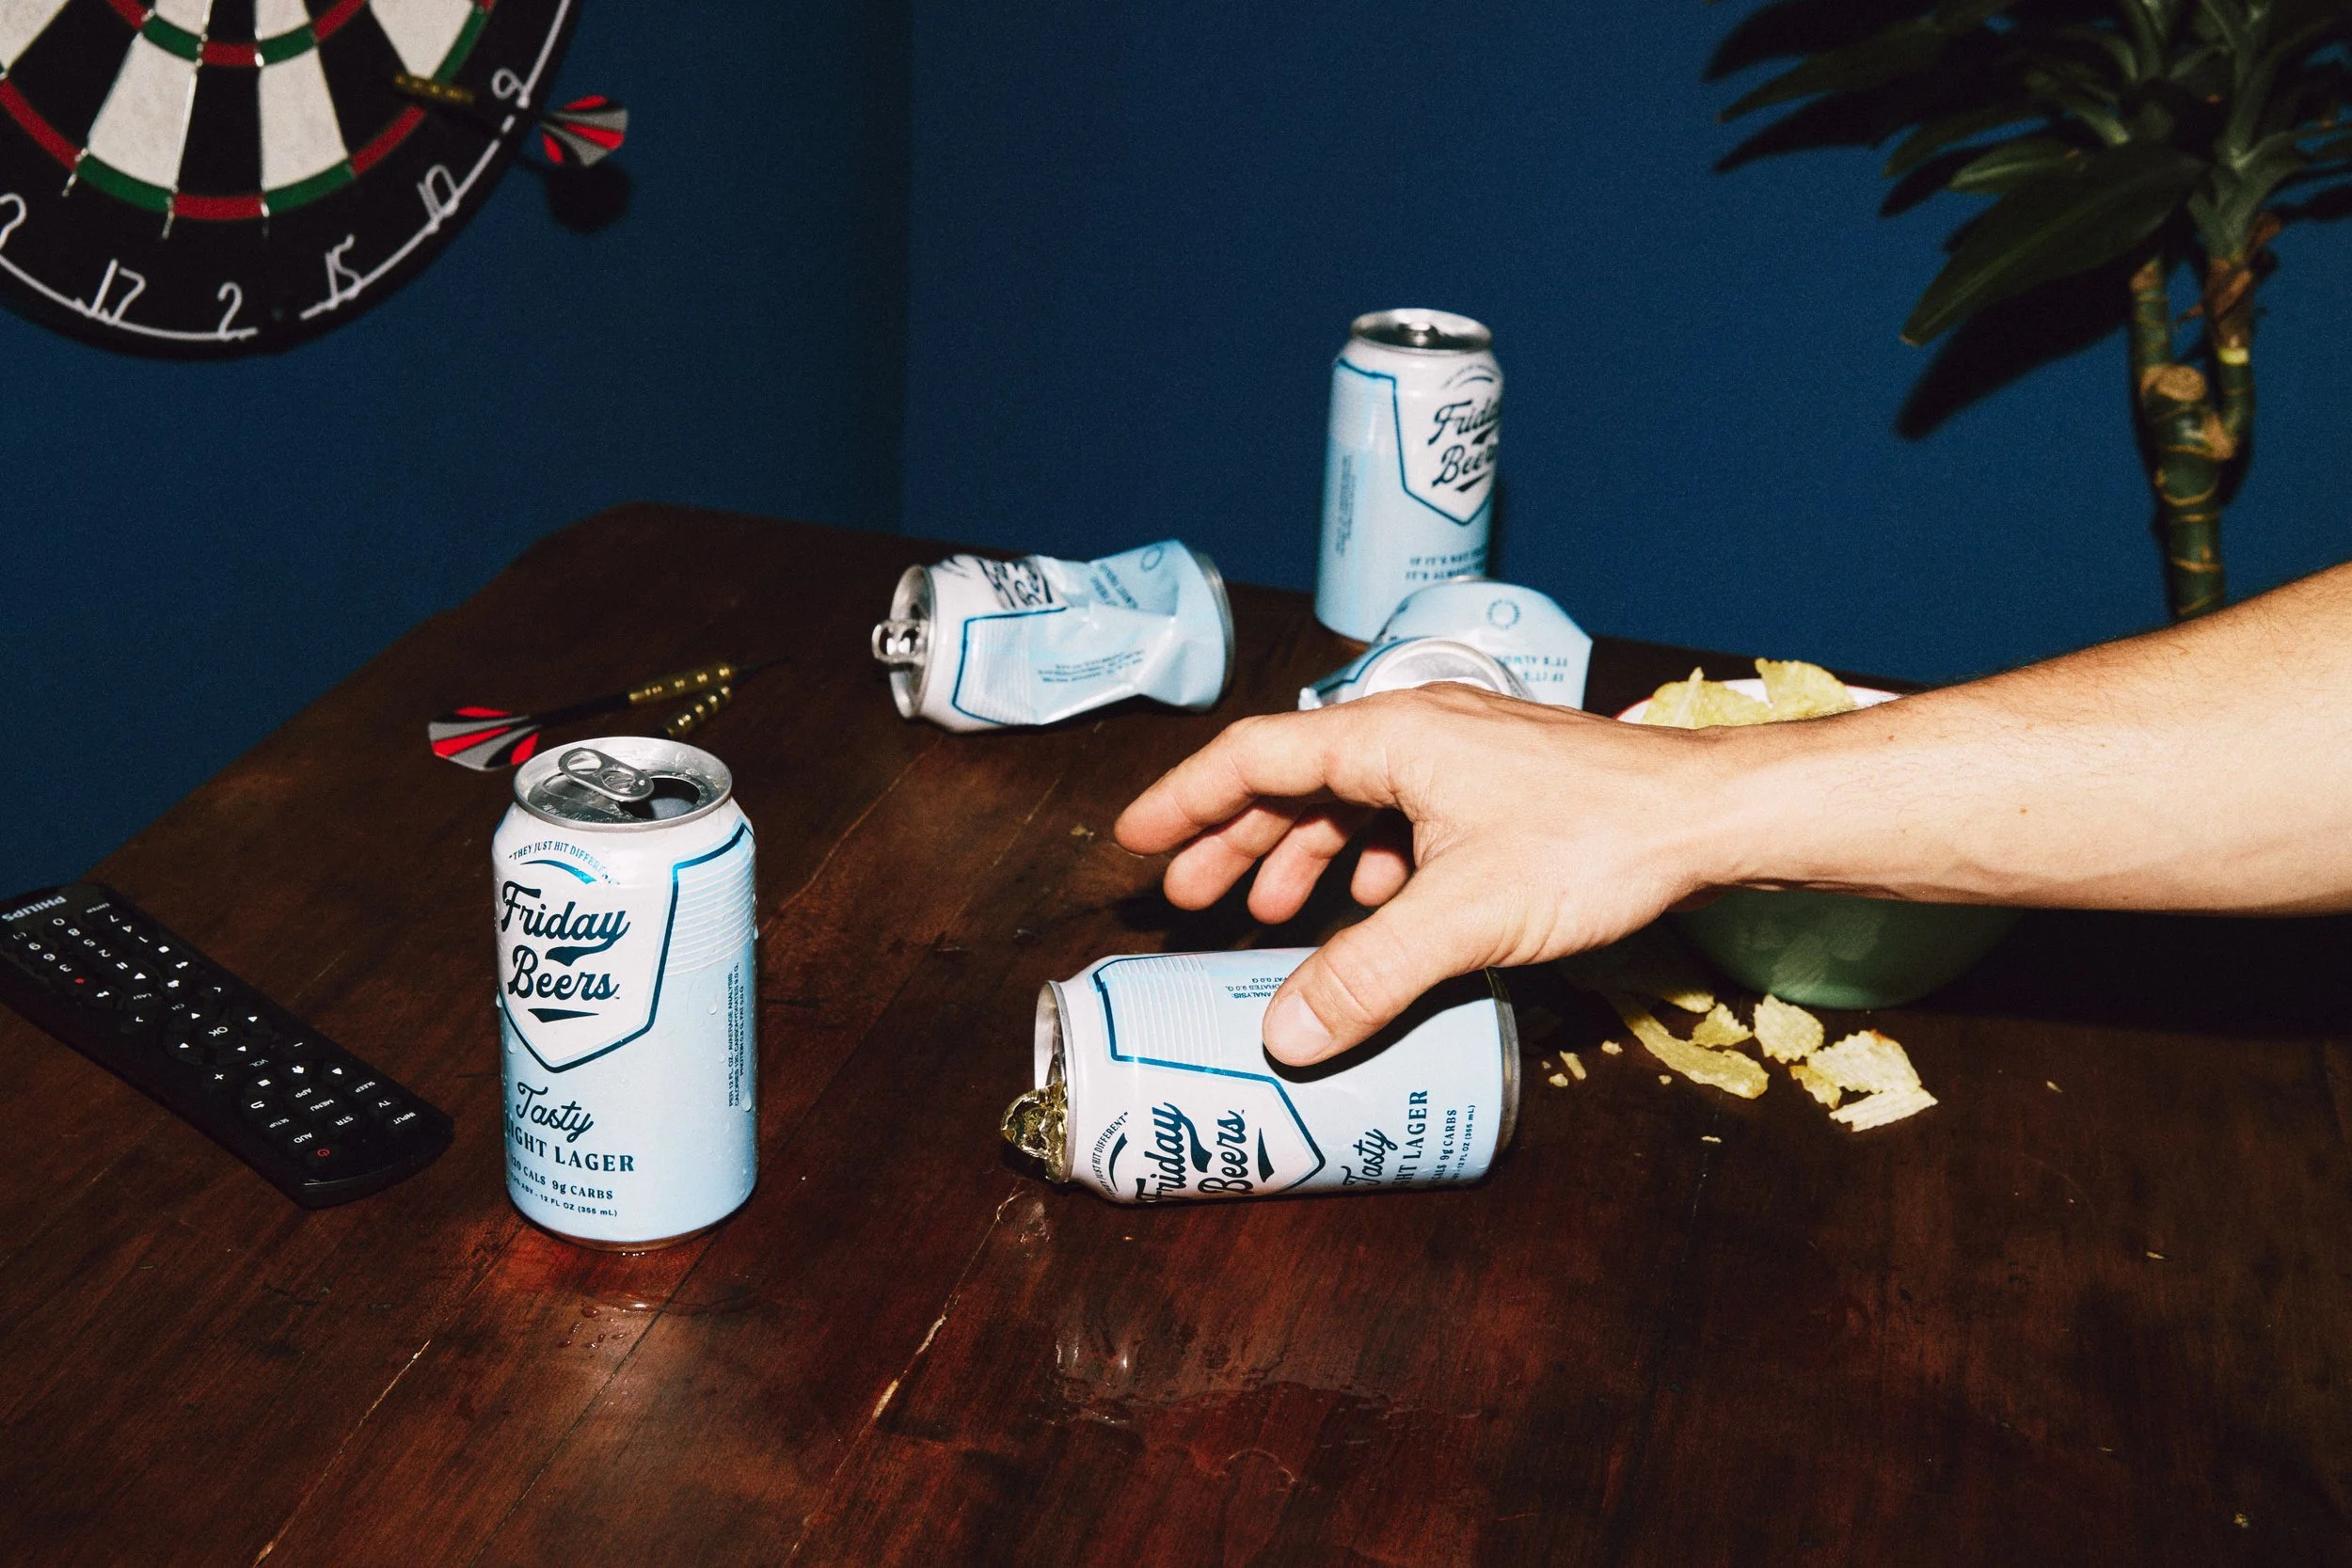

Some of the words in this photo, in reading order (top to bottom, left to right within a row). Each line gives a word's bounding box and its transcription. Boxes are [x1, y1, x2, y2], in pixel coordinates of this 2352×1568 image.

[417, 164, 460, 228] 10
[325, 234, 365, 305] 15
[89, 258, 147, 323] 17
[216, 282, 248, 341] 2
[533, 840, 553, 853] JUST
[554, 841, 569, 853] HIT
[1, 895, 67, 922] PHILIPS
[501, 880, 630, 967] Friday
[83, 939, 96, 947] 5
[98, 949, 111, 958] 2
[508, 944, 620, 1001] Beers
[208, 1026, 229, 1037] OK
[249, 1058, 269, 1067] VOL
[294, 1087, 312, 1099] APP
[355, 1081, 375, 1093] SLEEP
[728, 1081, 734, 1089] 12
[310, 1099, 334, 1112] MENU
[378, 1100, 391, 1108] TV
[516, 1081, 595, 1143] Tasty
[335, 1116, 354, 1126] STR
[392, 1111, 416, 1125] INPUT
[1402, 1090, 1428, 1159] LAGER
[1443, 1109, 1457, 1146] CARBS
[1464, 1124, 1473, 1140] (355
[294, 1132, 312, 1143] AUD
[1135, 1101, 1213, 1201] Friday
[1197, 1110, 1255, 1195] Beers
[1439, 1148, 1454, 1160] 9g
[1461, 1142, 1470, 1151] OZ
[554, 1146, 635, 1172] LAGER
[1091, 1151, 1102, 1165] HIT
[1341, 1129, 1399, 1185] Tasty
[1459, 1153, 1468, 1162] FL
[1431, 1164, 1447, 1180] CALS
[523, 1166, 546, 1186] CALS
[551, 1180, 566, 1195] 9g
[570, 1185, 613, 1200] CARBS
[540, 1194, 548, 1203] 12
[550, 1198, 560, 1207] FL
[563, 1202, 575, 1211] OZ
[577, 1205, 596, 1214] (355
[599, 1209, 618, 1217] mL)
